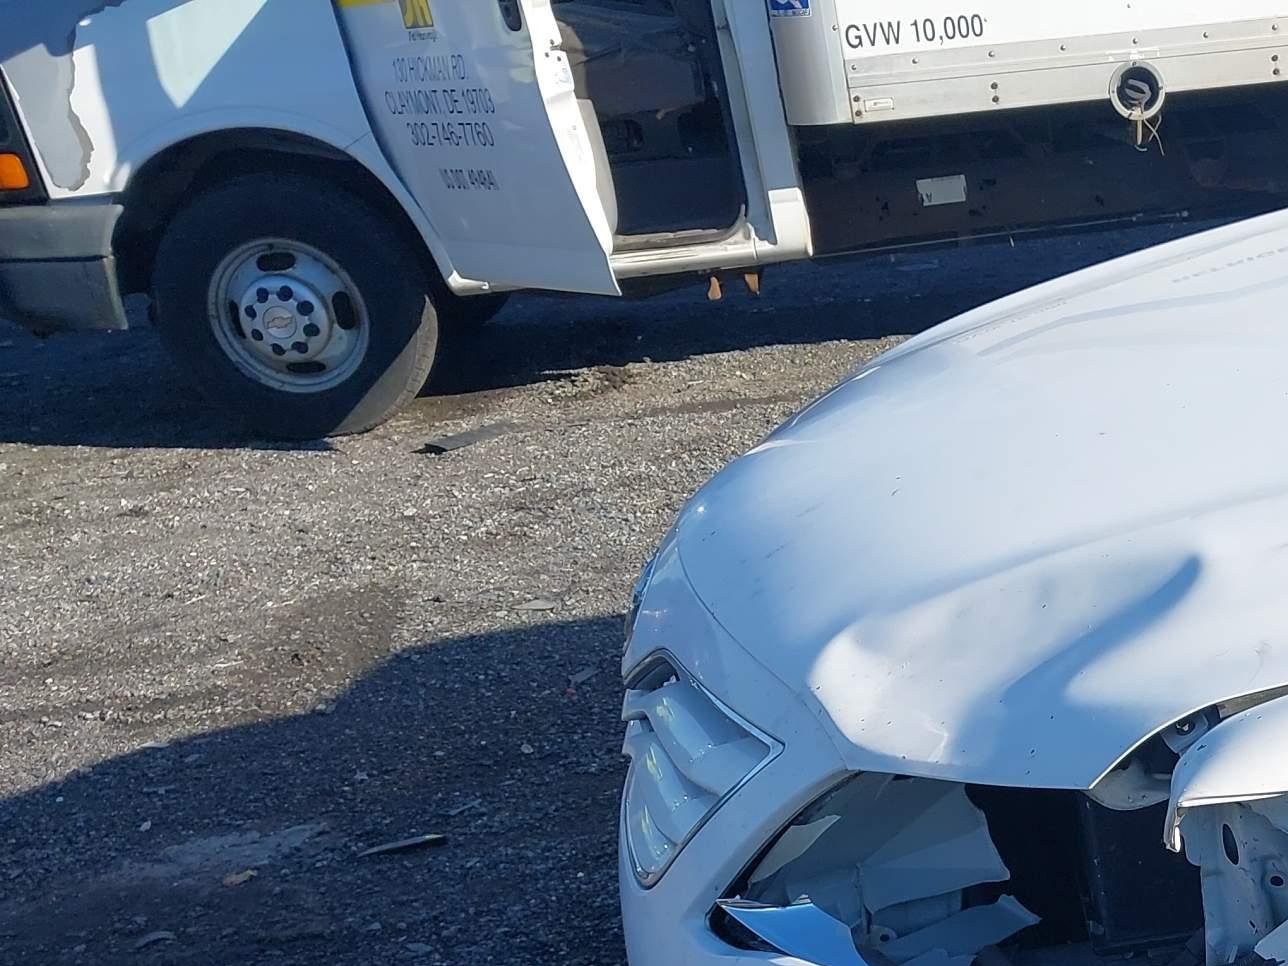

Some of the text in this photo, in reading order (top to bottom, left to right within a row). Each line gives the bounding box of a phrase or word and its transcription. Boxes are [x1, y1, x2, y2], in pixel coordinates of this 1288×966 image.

[844, 13, 984, 49] GVW 10,000
[442, 88, 463, 114] DE
[461, 87, 495, 115] 19703
[406, 121, 495, 147] 302-746-7760
